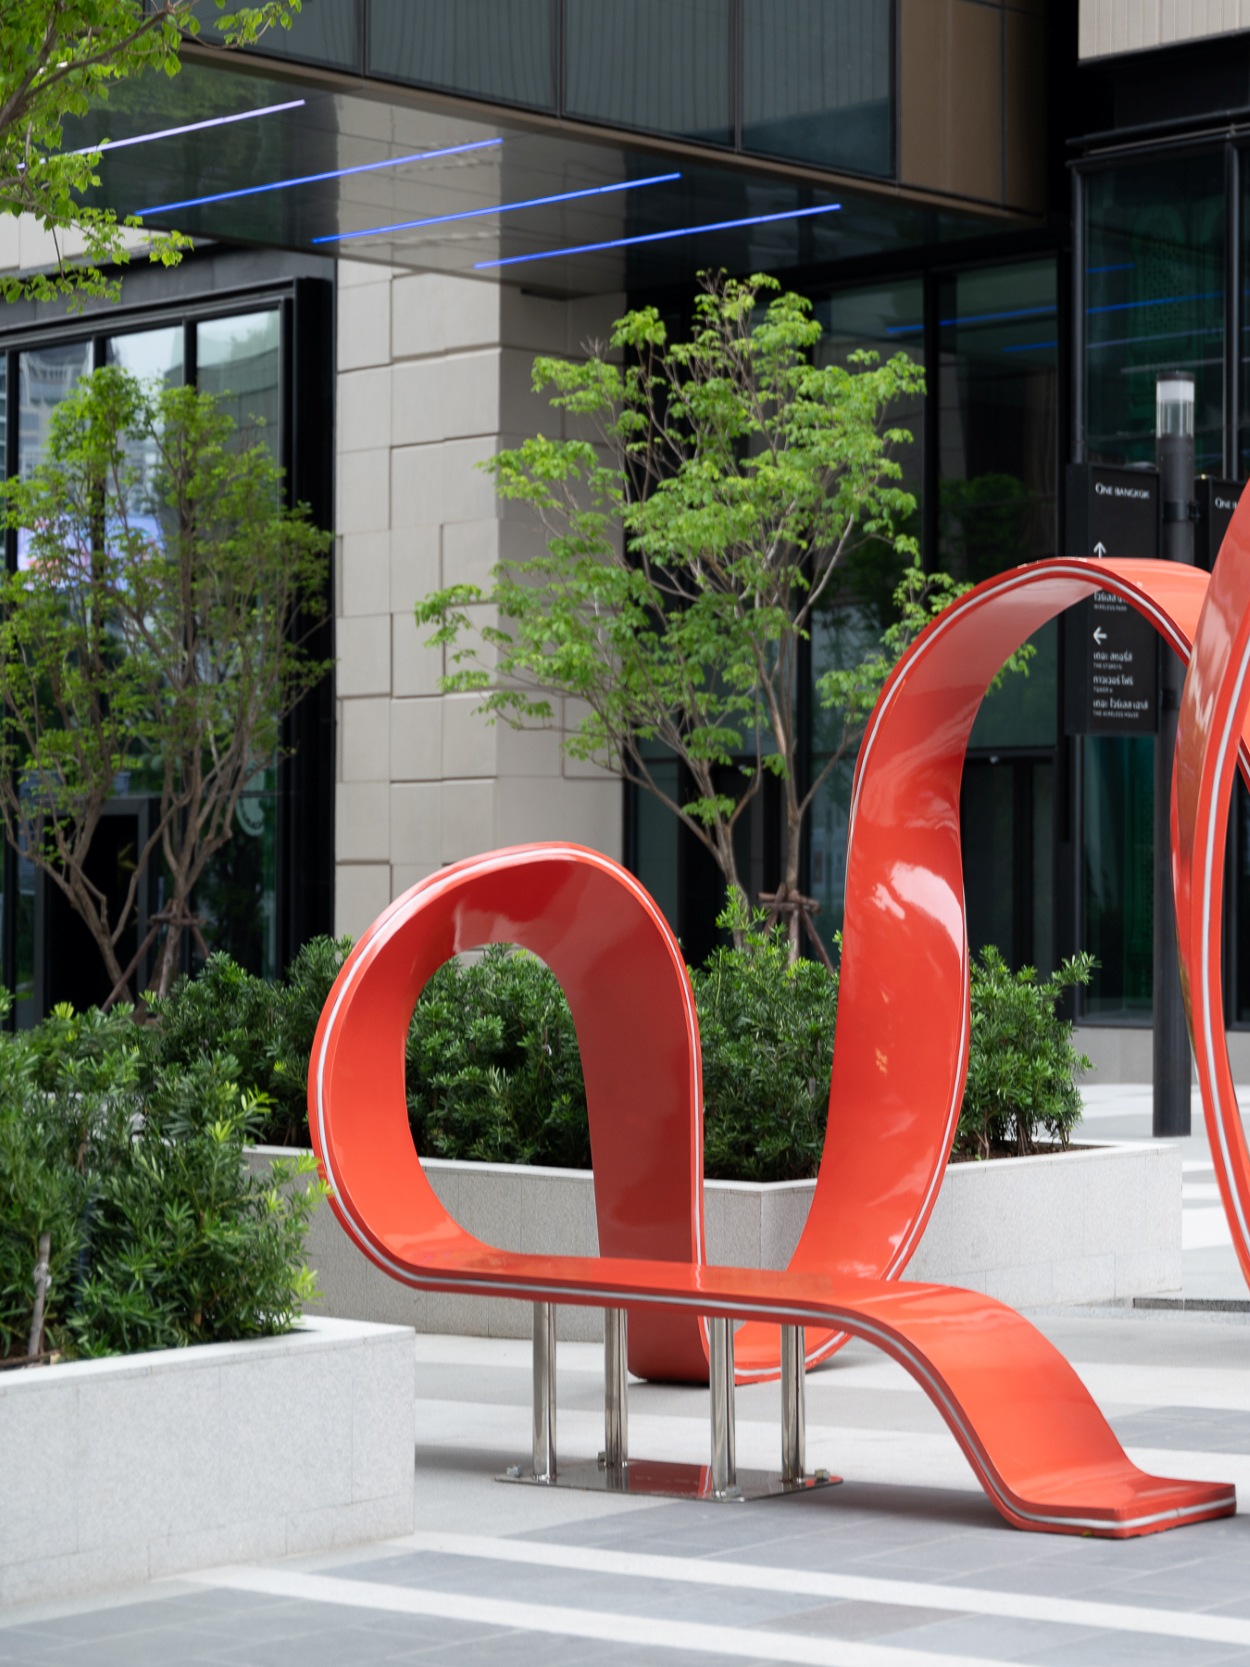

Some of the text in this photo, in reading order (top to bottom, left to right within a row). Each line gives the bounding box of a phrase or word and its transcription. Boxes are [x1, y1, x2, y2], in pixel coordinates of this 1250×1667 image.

[1095, 482, 1150, 499] ONE BANGKOK
[1214, 496, 1231, 509] ONE
